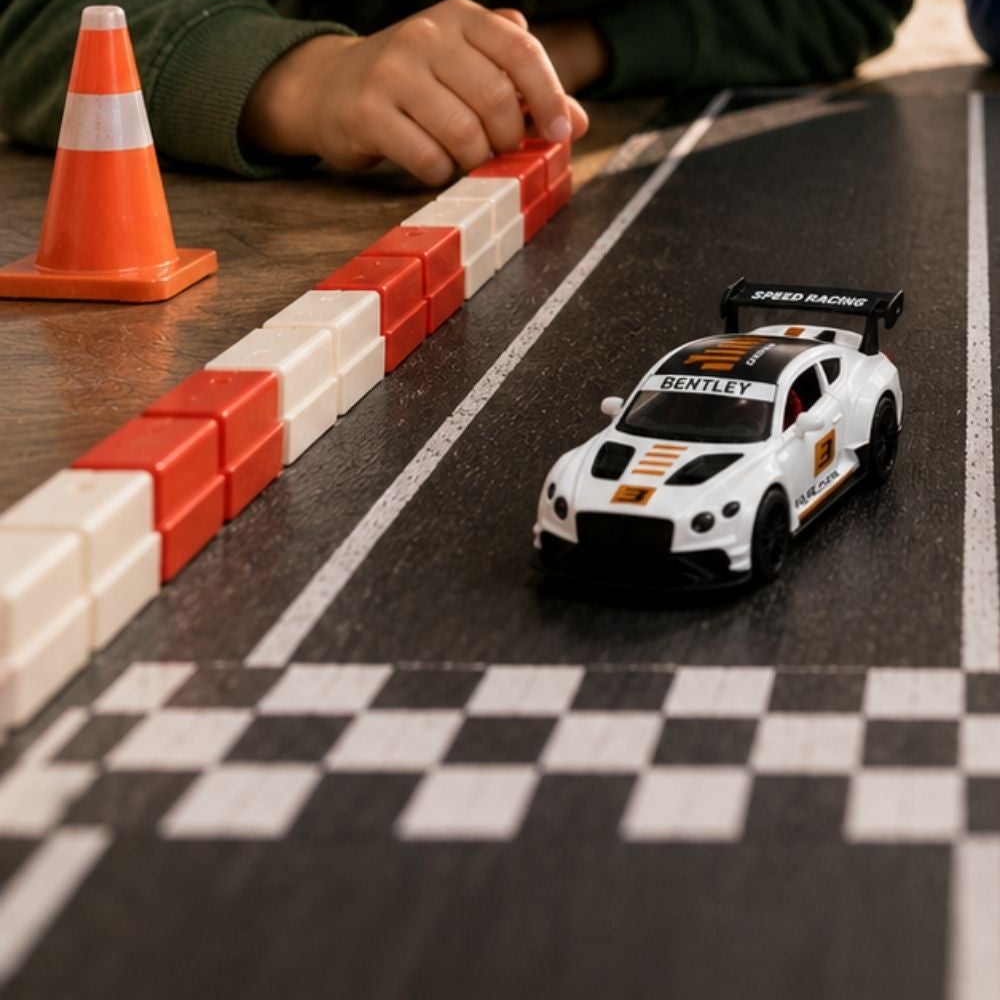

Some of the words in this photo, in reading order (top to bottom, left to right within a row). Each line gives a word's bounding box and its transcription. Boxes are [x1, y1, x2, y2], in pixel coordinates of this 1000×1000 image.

[751, 290, 804, 302] SPEED
[805, 294, 869, 308] RACING
[660, 376, 752, 396] BENTLEY
